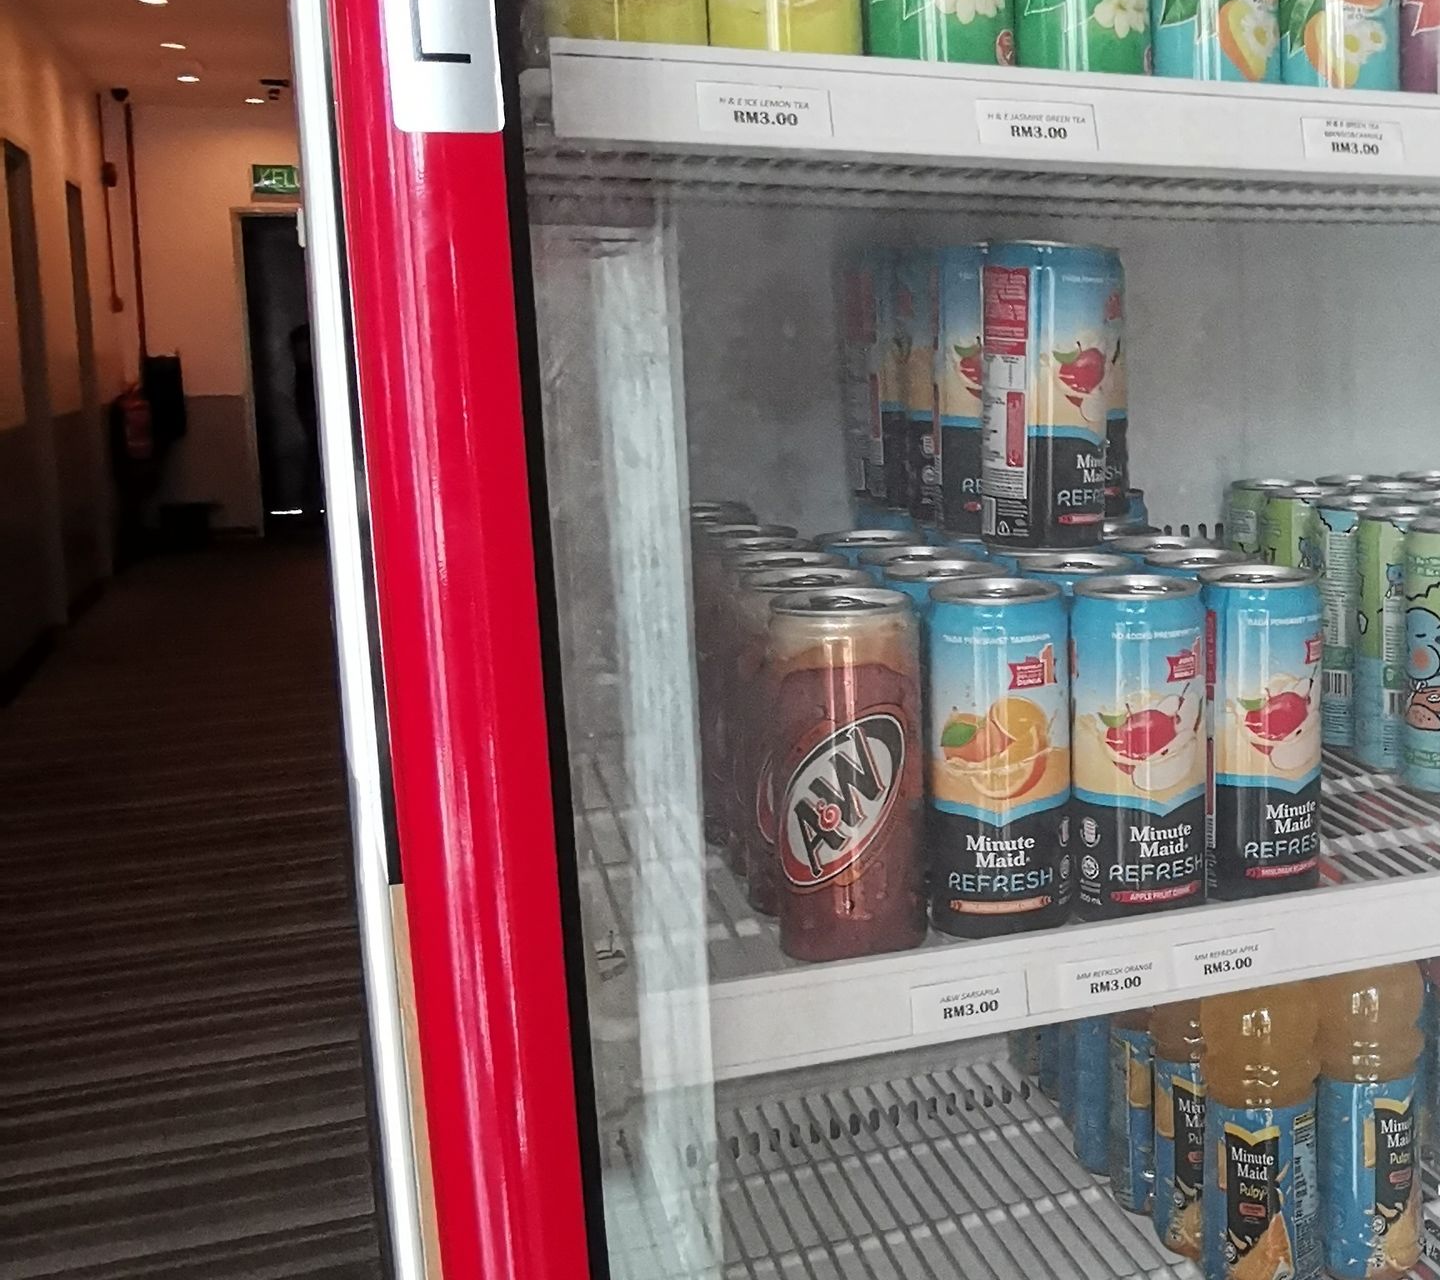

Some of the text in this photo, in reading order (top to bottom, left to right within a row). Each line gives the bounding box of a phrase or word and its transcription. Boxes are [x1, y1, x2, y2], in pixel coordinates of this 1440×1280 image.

[760, 99, 791, 108] LEMON
[793, 101, 809, 110] TEA
[733, 110, 798, 127] RM3.00
[1010, 125, 1068, 140] RM3.00
[1331, 141, 1380, 156] RM3.00
[793, 724, 887, 879] A&W
[1265, 801, 1317, 820] Minute
[1130, 822, 1192, 843] Minute
[1273, 816, 1313, 836] Maid
[965, 833, 1036, 854] Minute
[1139, 841, 1188, 859] Maid
[975, 850, 1029, 869] Maid
[1108, 856, 1203, 885] REFRESH
[948, 867, 1054, 894] REFRESH
[1203, 956, 1253, 976] RM3.00
[1090, 975, 1142, 994] RM3.00
[943, 999, 999, 1020] RM3.00
[1231, 1146, 1275, 1166] Minute
[1237, 1162, 1268, 1181] Maid
[1239, 1182, 1266, 1201] Pulpy
